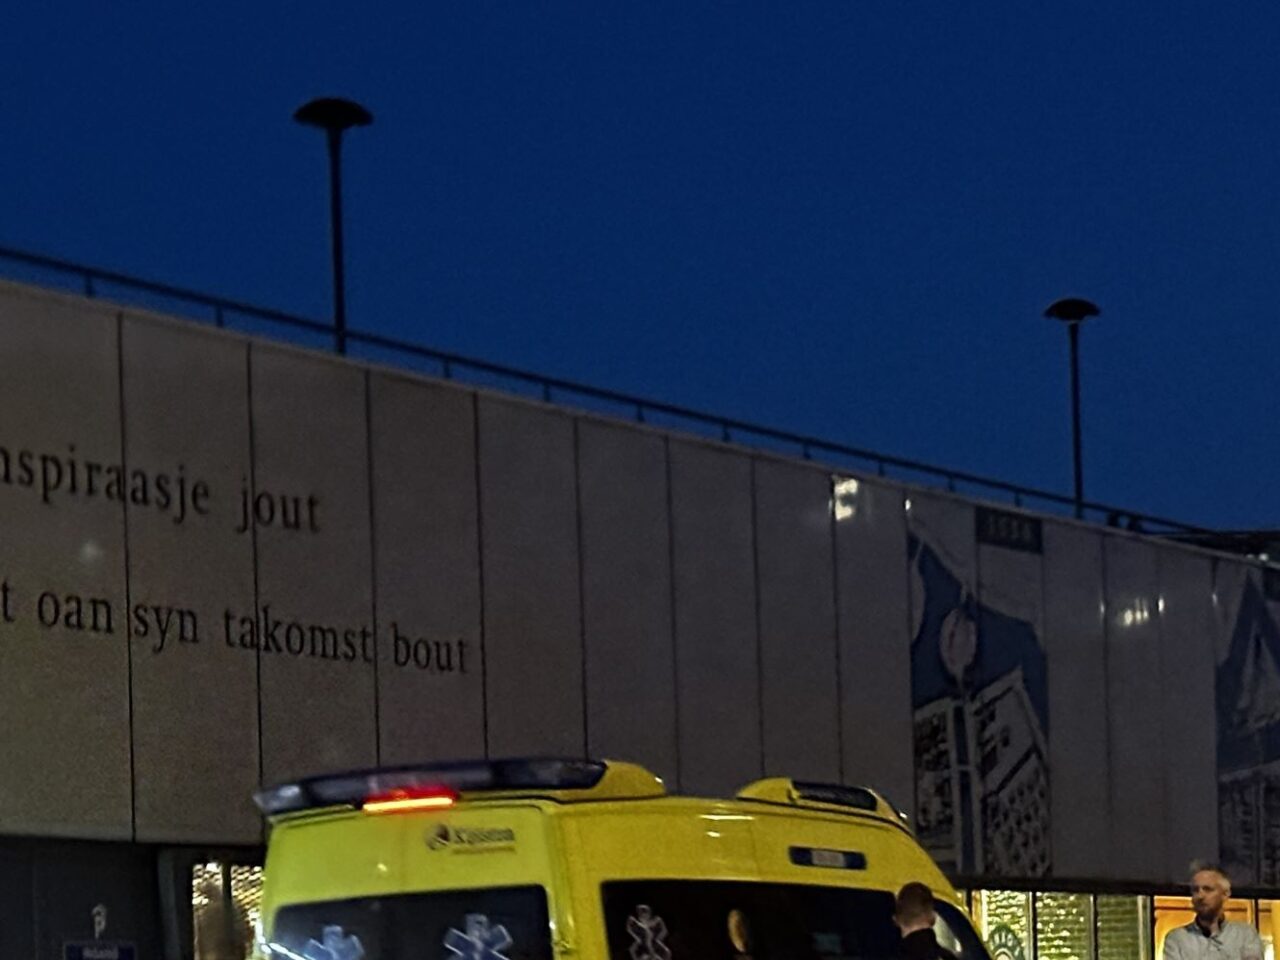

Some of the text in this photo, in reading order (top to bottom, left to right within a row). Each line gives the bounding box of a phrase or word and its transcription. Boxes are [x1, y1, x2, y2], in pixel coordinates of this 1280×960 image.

[234, 474, 319, 534] jout
[37, 591, 114, 633] oan
[133, 603, 199, 654] syn
[224, 605, 373, 663] takomst
[392, 621, 467, 673] bout
